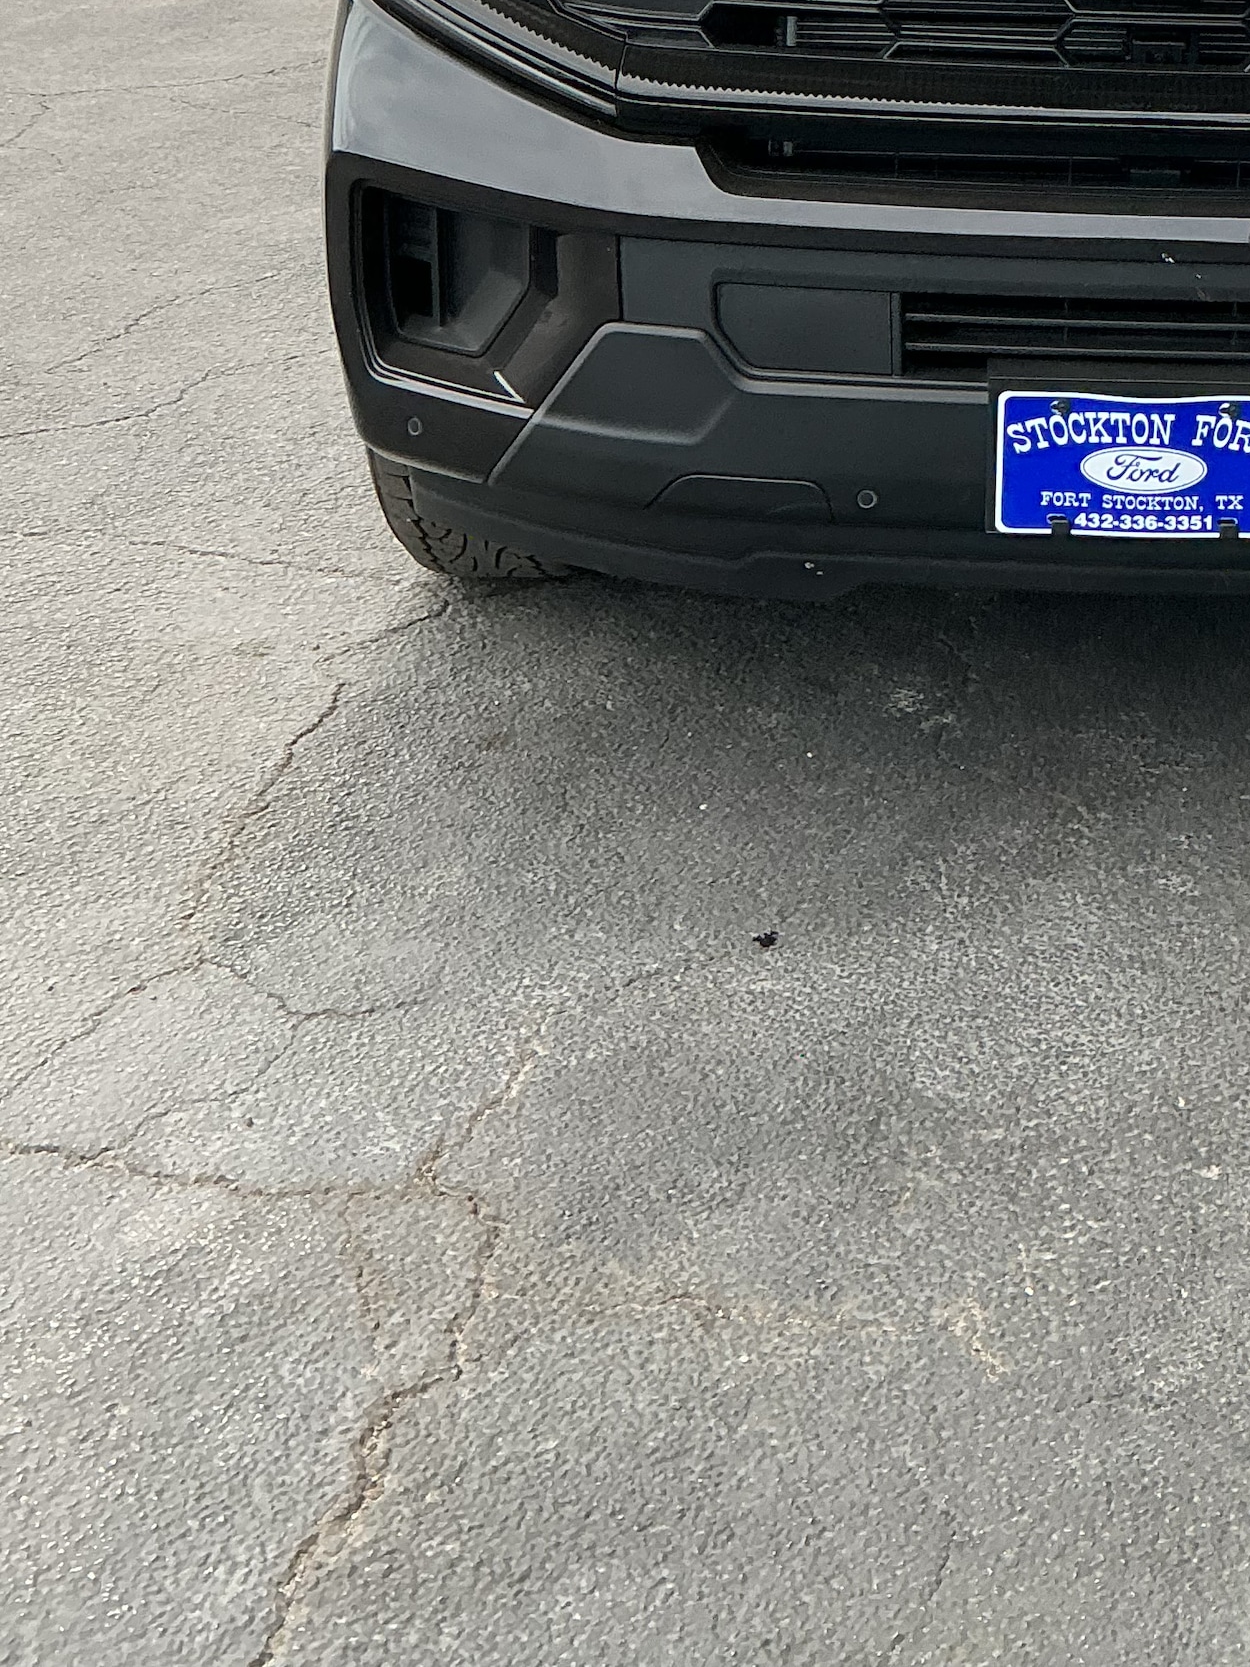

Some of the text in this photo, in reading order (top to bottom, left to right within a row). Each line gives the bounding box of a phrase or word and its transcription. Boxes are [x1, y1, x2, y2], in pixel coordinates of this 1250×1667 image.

[1006, 411, 1176, 455] STOCKTON
[1106, 453, 1180, 484] Ford
[1040, 490, 1244, 513] FORT STOCKTON, TX
[1074, 512, 1213, 531] 432-336-3351
